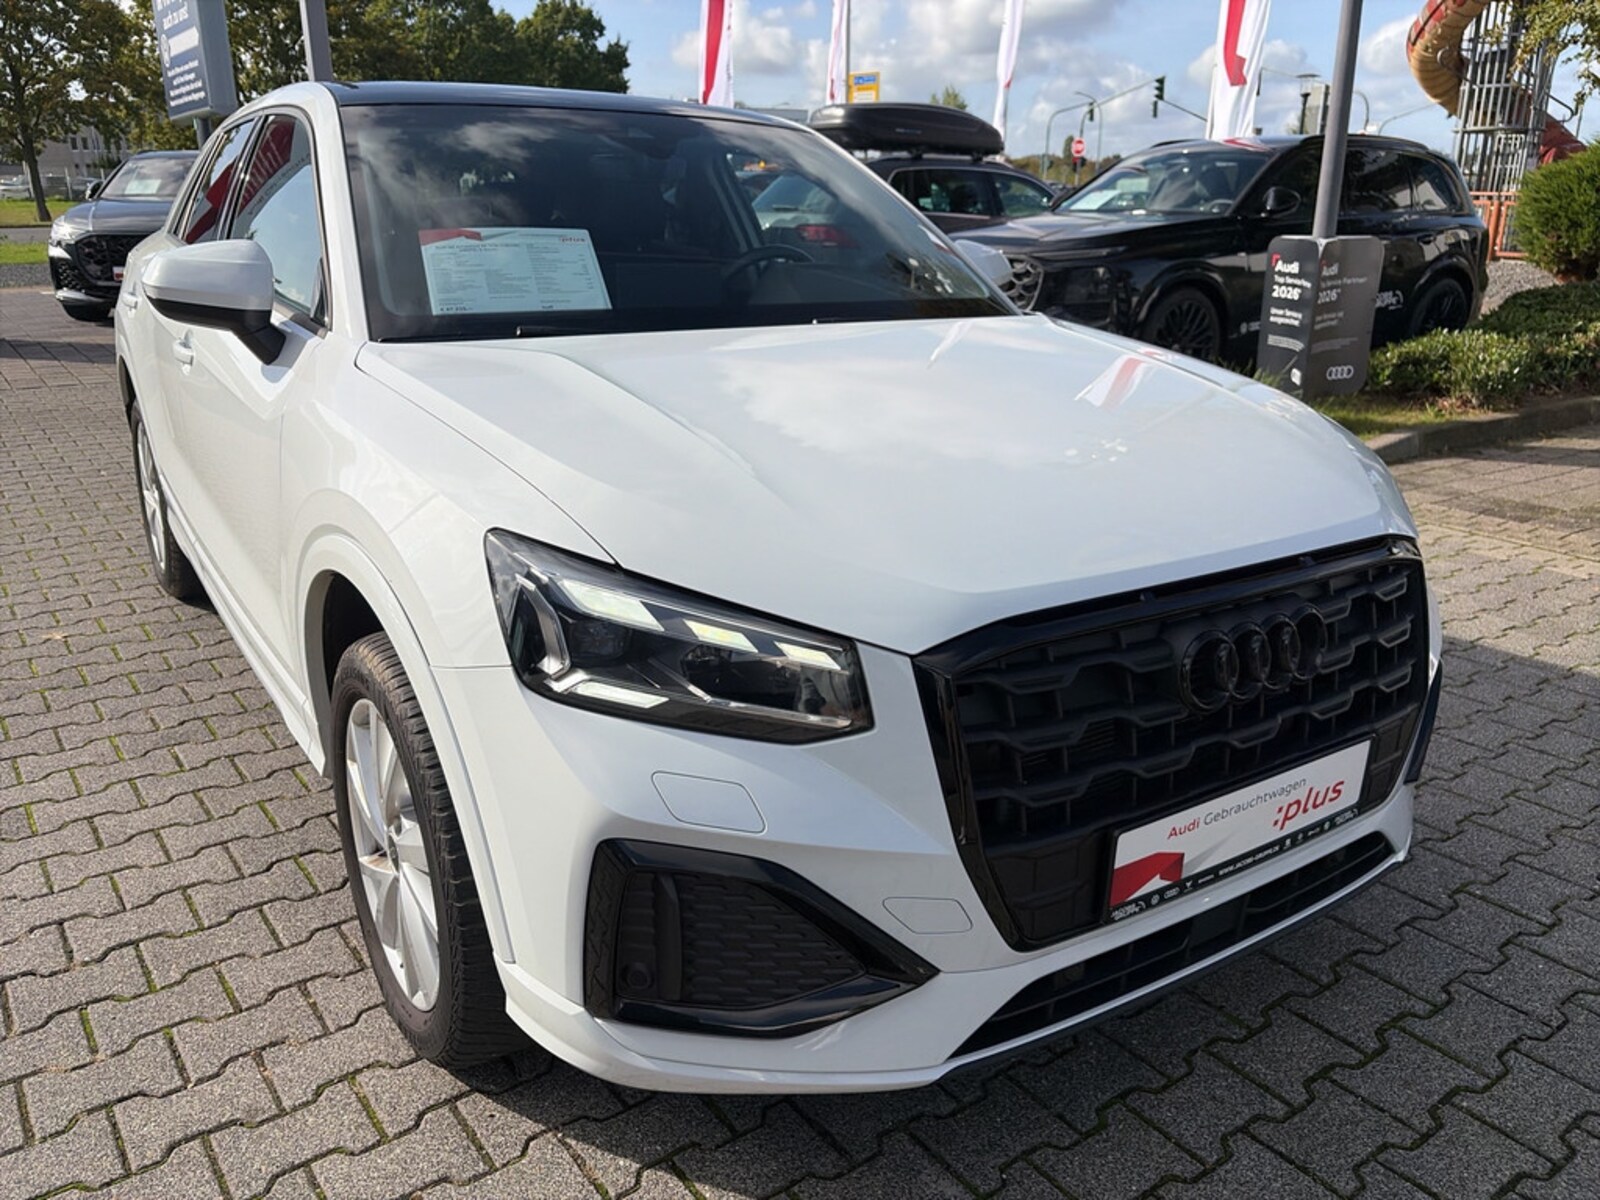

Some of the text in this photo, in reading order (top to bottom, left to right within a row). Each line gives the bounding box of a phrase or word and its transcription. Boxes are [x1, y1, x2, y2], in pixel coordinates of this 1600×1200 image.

[1274, 260, 1299, 274] Audi
[1168, 817, 1200, 839] Audi
[1204, 778, 1307, 826] Gebrauchtwagen
[1273, 781, 1345, 830] :plus
